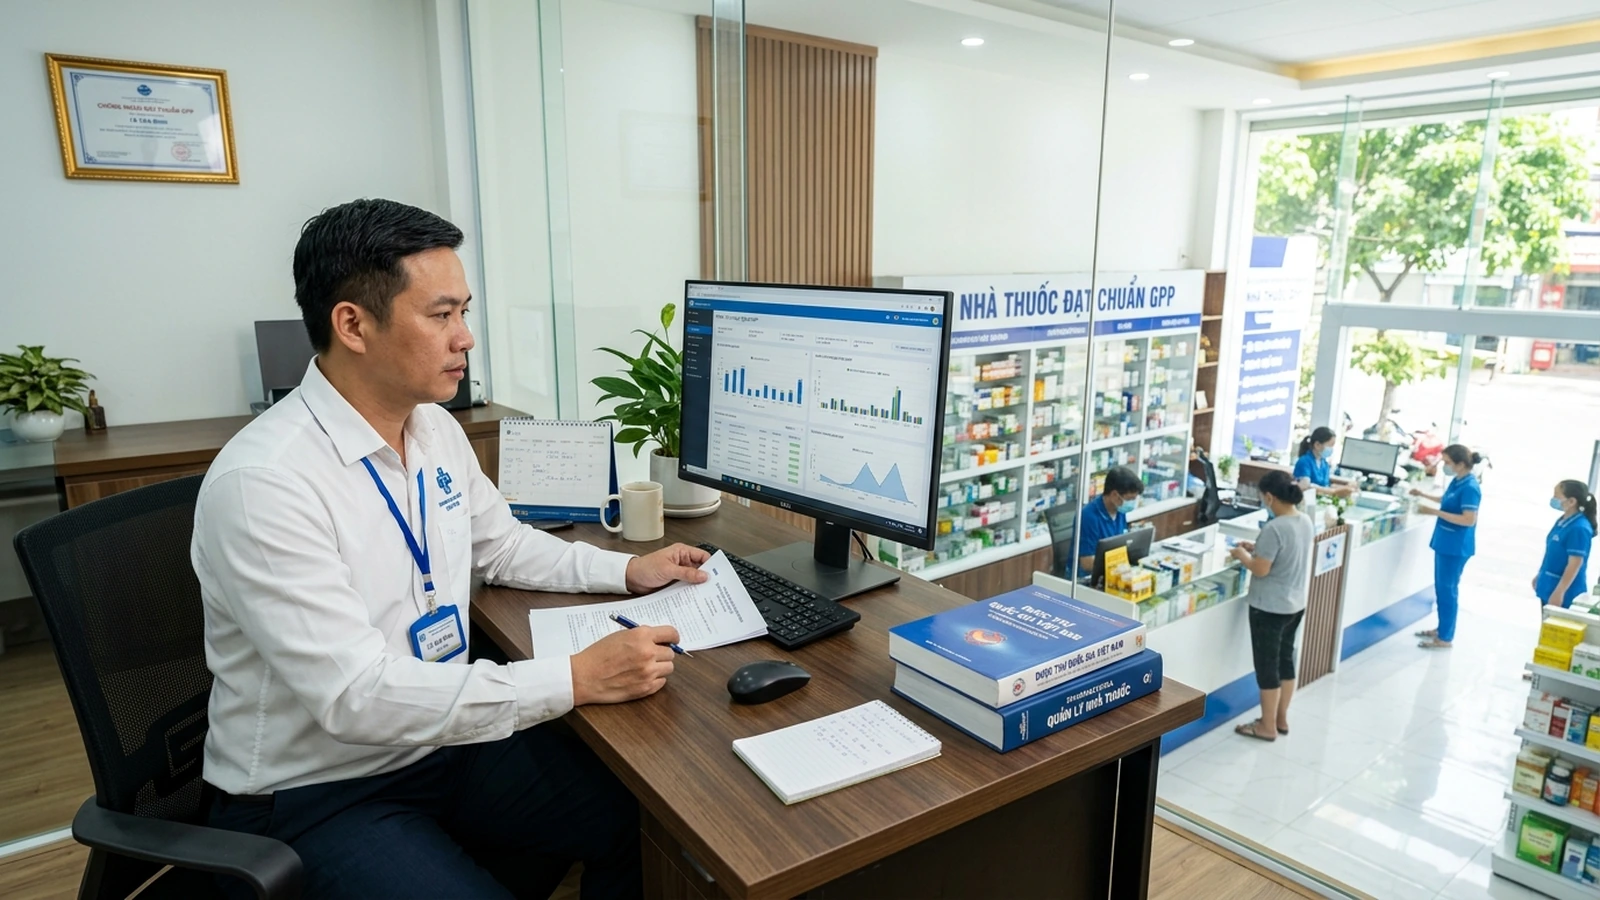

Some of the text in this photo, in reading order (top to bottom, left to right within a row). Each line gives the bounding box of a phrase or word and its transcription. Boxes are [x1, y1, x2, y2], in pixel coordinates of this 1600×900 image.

[960, 274, 1176, 320] NHÀ THUỐC ĐẠT CHUẨN GPP
